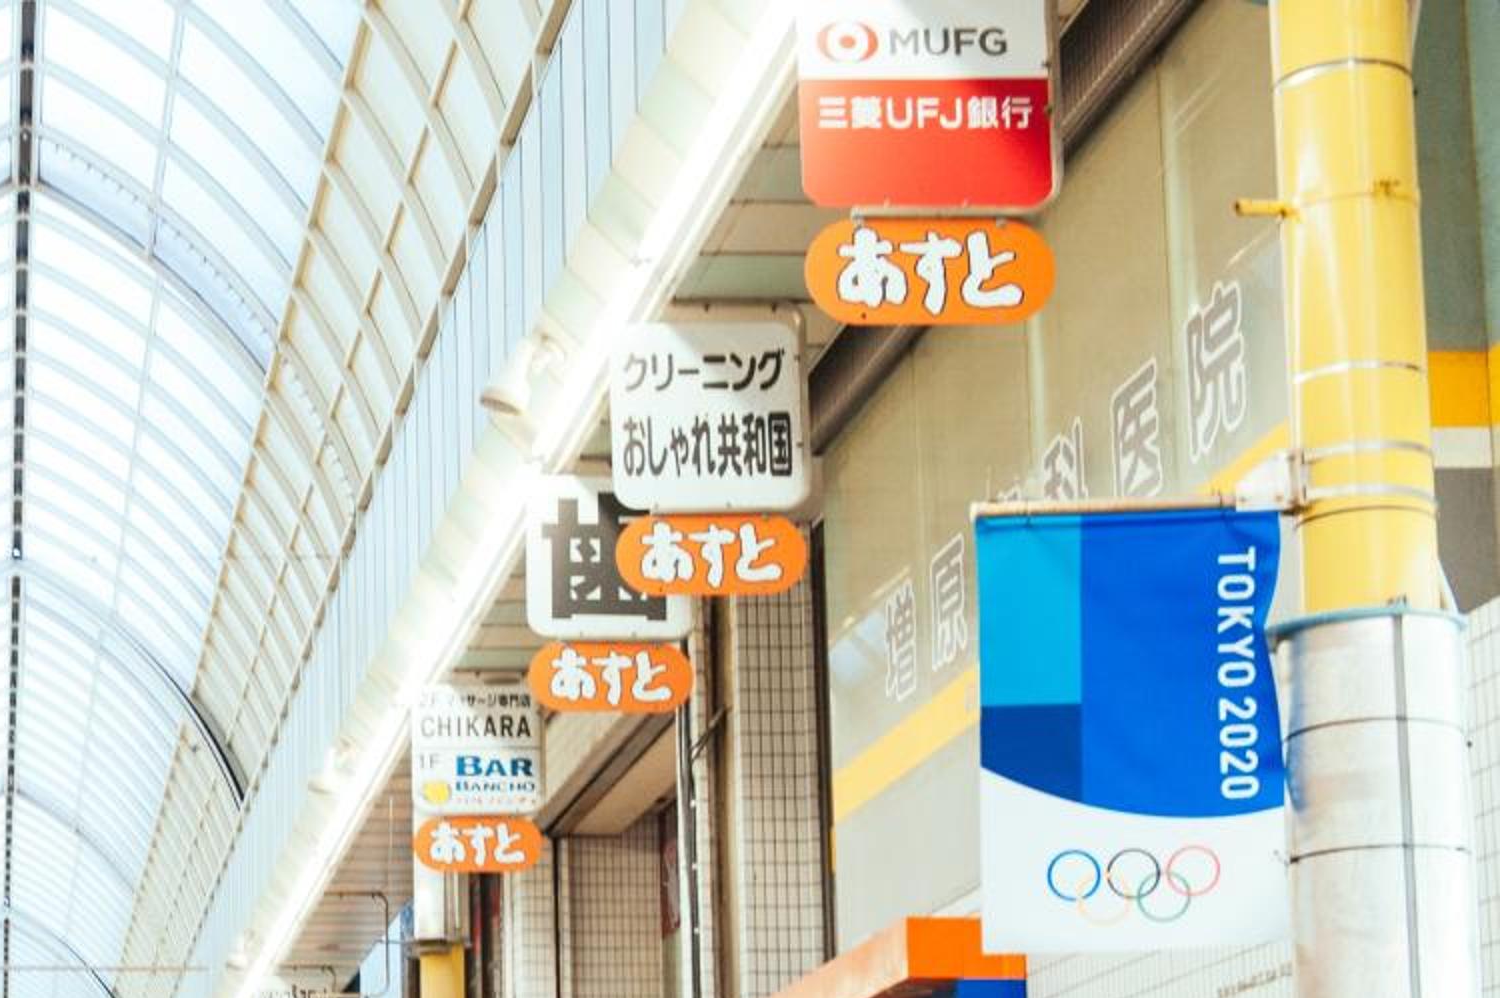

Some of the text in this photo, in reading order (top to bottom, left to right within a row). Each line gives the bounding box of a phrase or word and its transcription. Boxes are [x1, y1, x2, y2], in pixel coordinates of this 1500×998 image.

[888, 27, 1008, 57] MUFG
[818, 96, 1033, 131] 三菱UFJ銀行
[838, 228, 1025, 316] あすと
[622, 350, 785, 392] クリーニング
[622, 412, 794, 479] おしゃれ共和国
[641, 523, 783, 588] あすと
[549, 648, 673, 706] あすと
[1217, 545, 1261, 802] TOKYO 2020
[420, 715, 532, 738] CHIKARA
[455, 755, 533, 777] BAR
[429, 823, 525, 864] あすと
